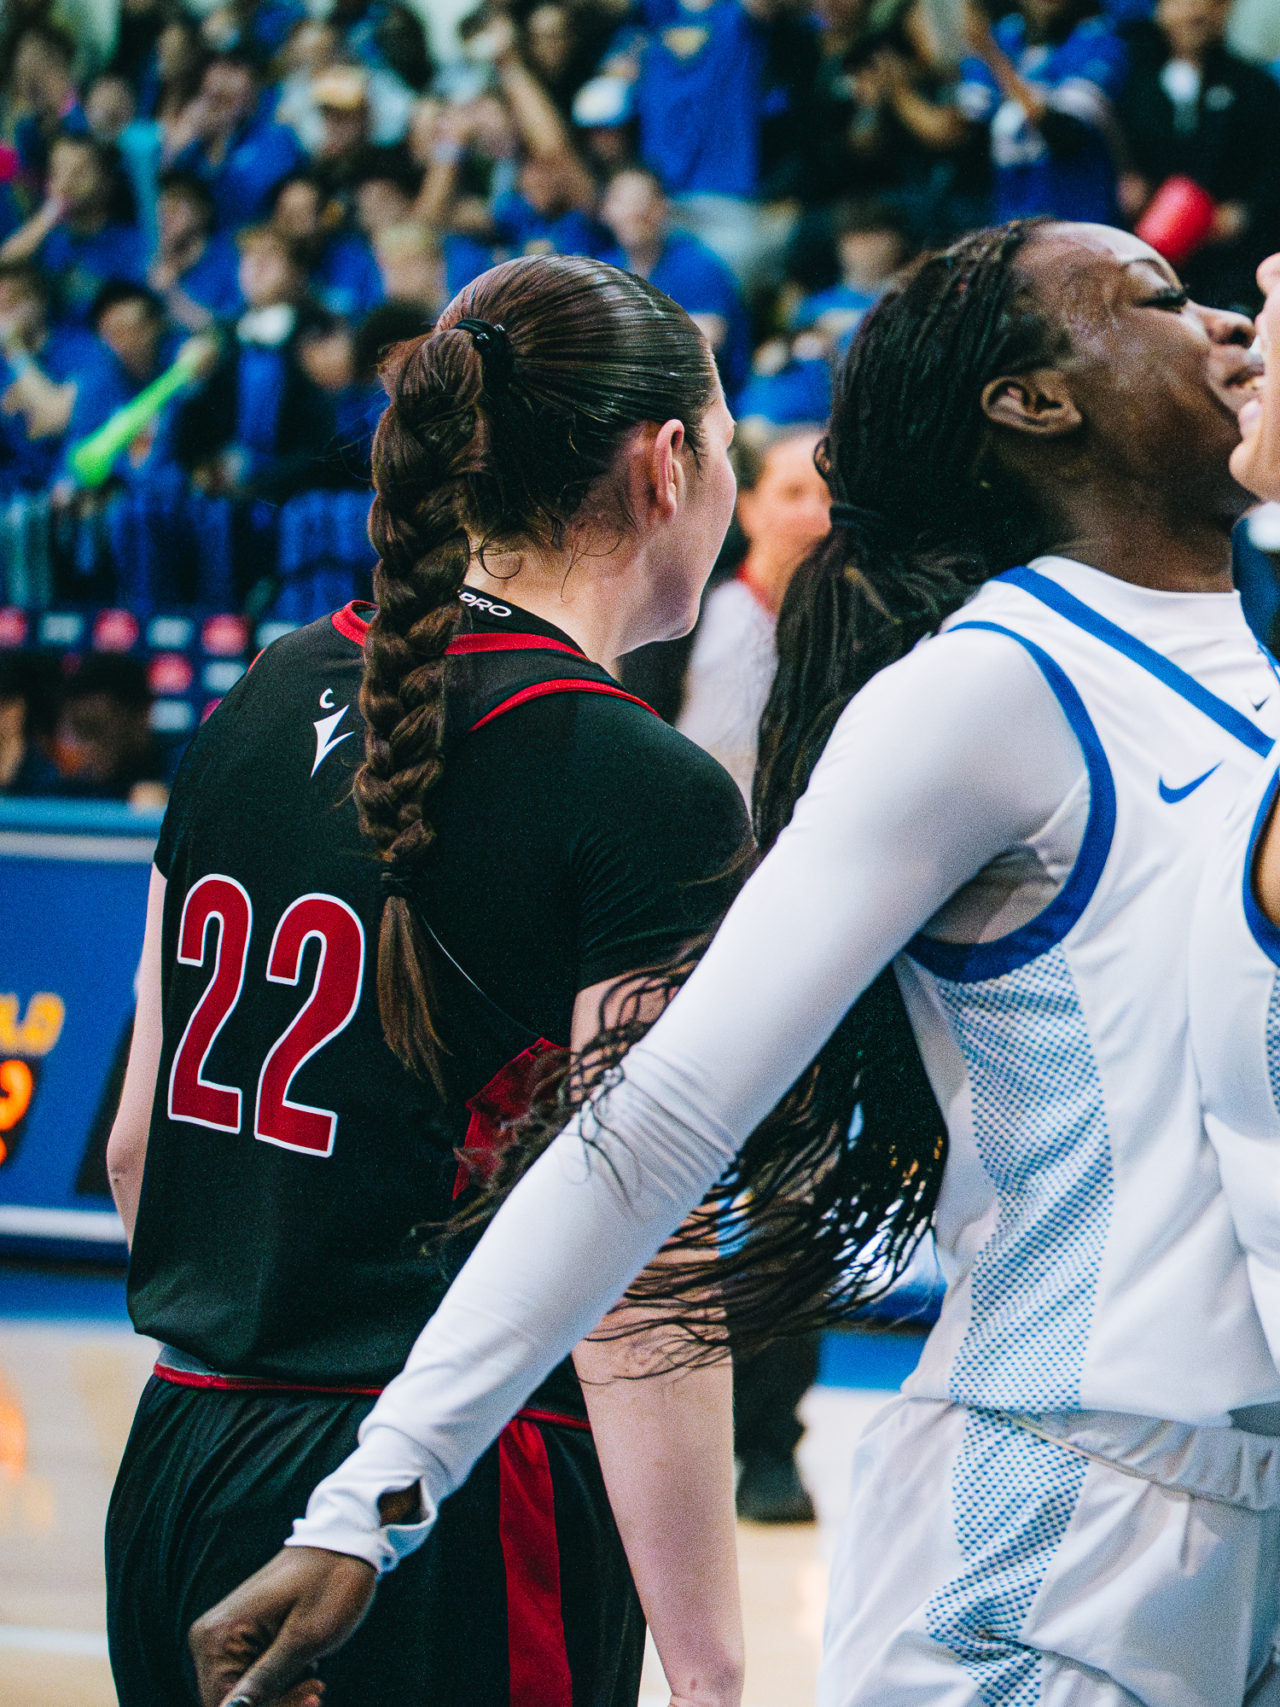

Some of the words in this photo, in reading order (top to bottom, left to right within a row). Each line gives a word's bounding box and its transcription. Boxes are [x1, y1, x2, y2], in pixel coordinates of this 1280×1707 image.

[458, 592, 513, 617] PRO
[319, 687, 336, 709] C
[167, 873, 365, 1158] 22
